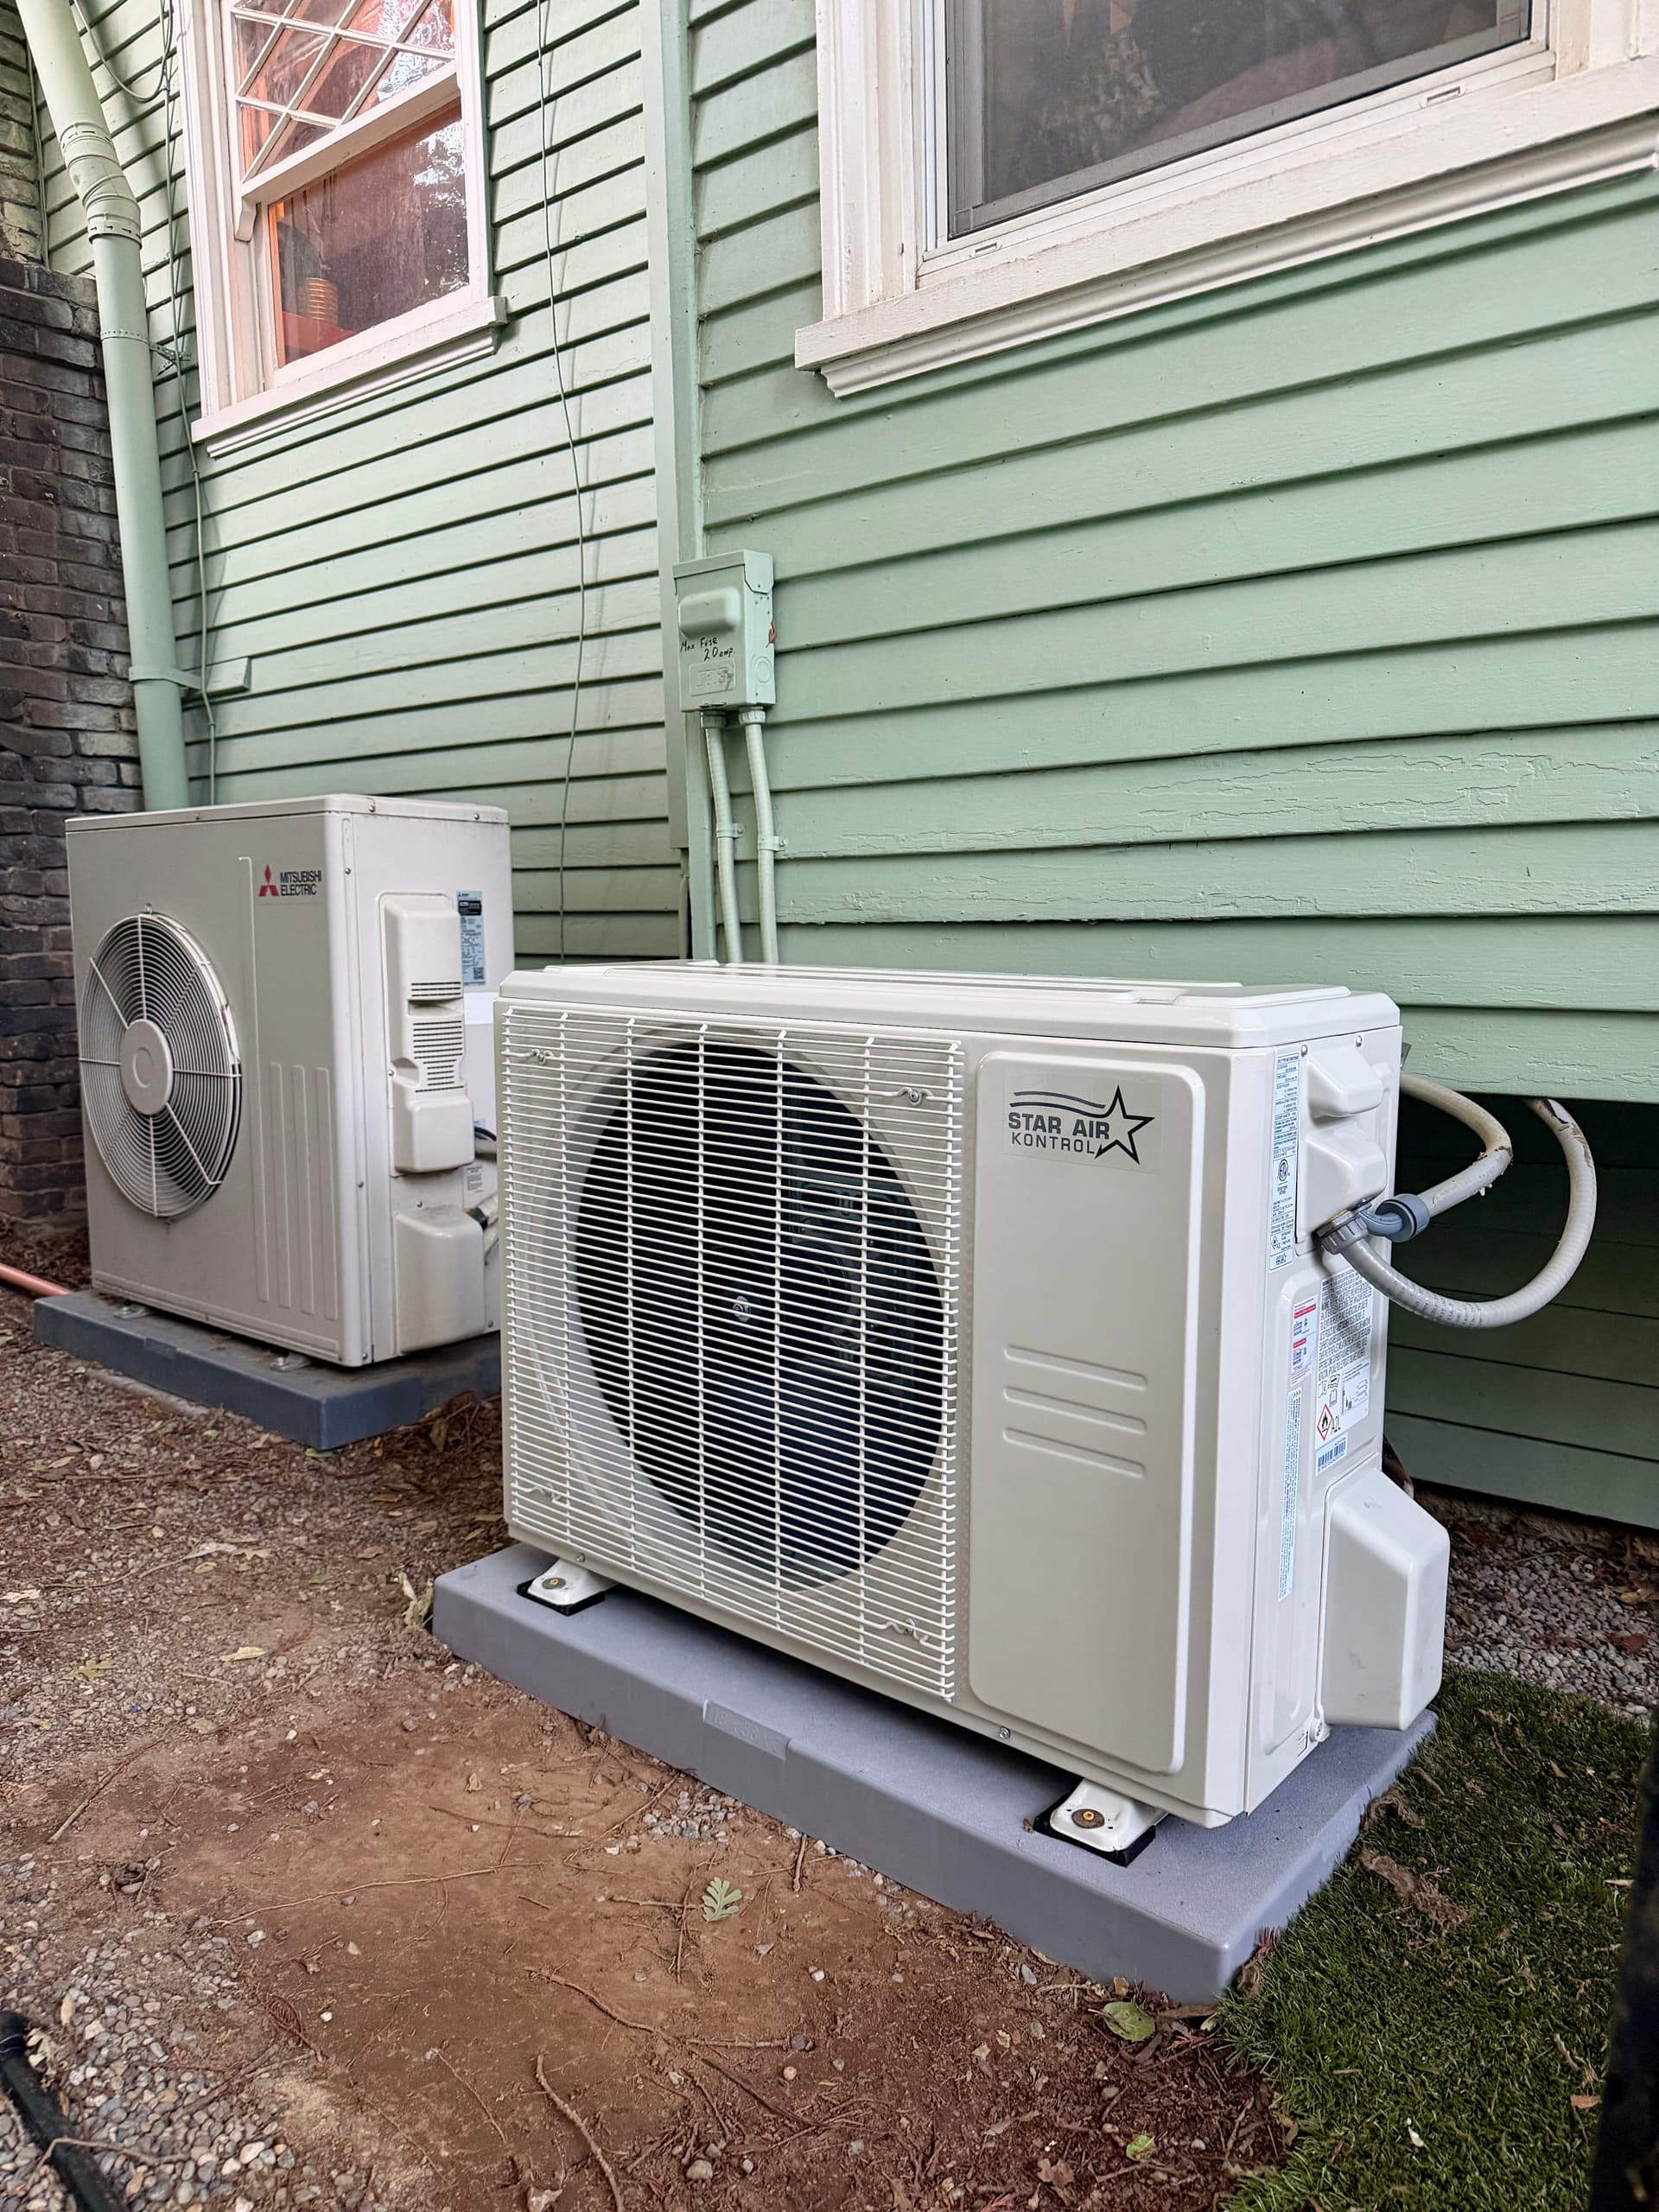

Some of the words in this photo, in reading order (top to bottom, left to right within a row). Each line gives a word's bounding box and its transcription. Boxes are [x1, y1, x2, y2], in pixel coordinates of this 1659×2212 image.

[700, 637, 717, 648] Fuse
[703, 646, 719, 661] 20
[280, 870, 322, 884] MITSUBISHI
[281, 883, 317, 896] ELECTRIC
[1008, 1112, 1062, 1134] STAR
[1072, 1119, 1109, 1140] AIR
[1012, 1131, 1096, 1154] KONTROL
